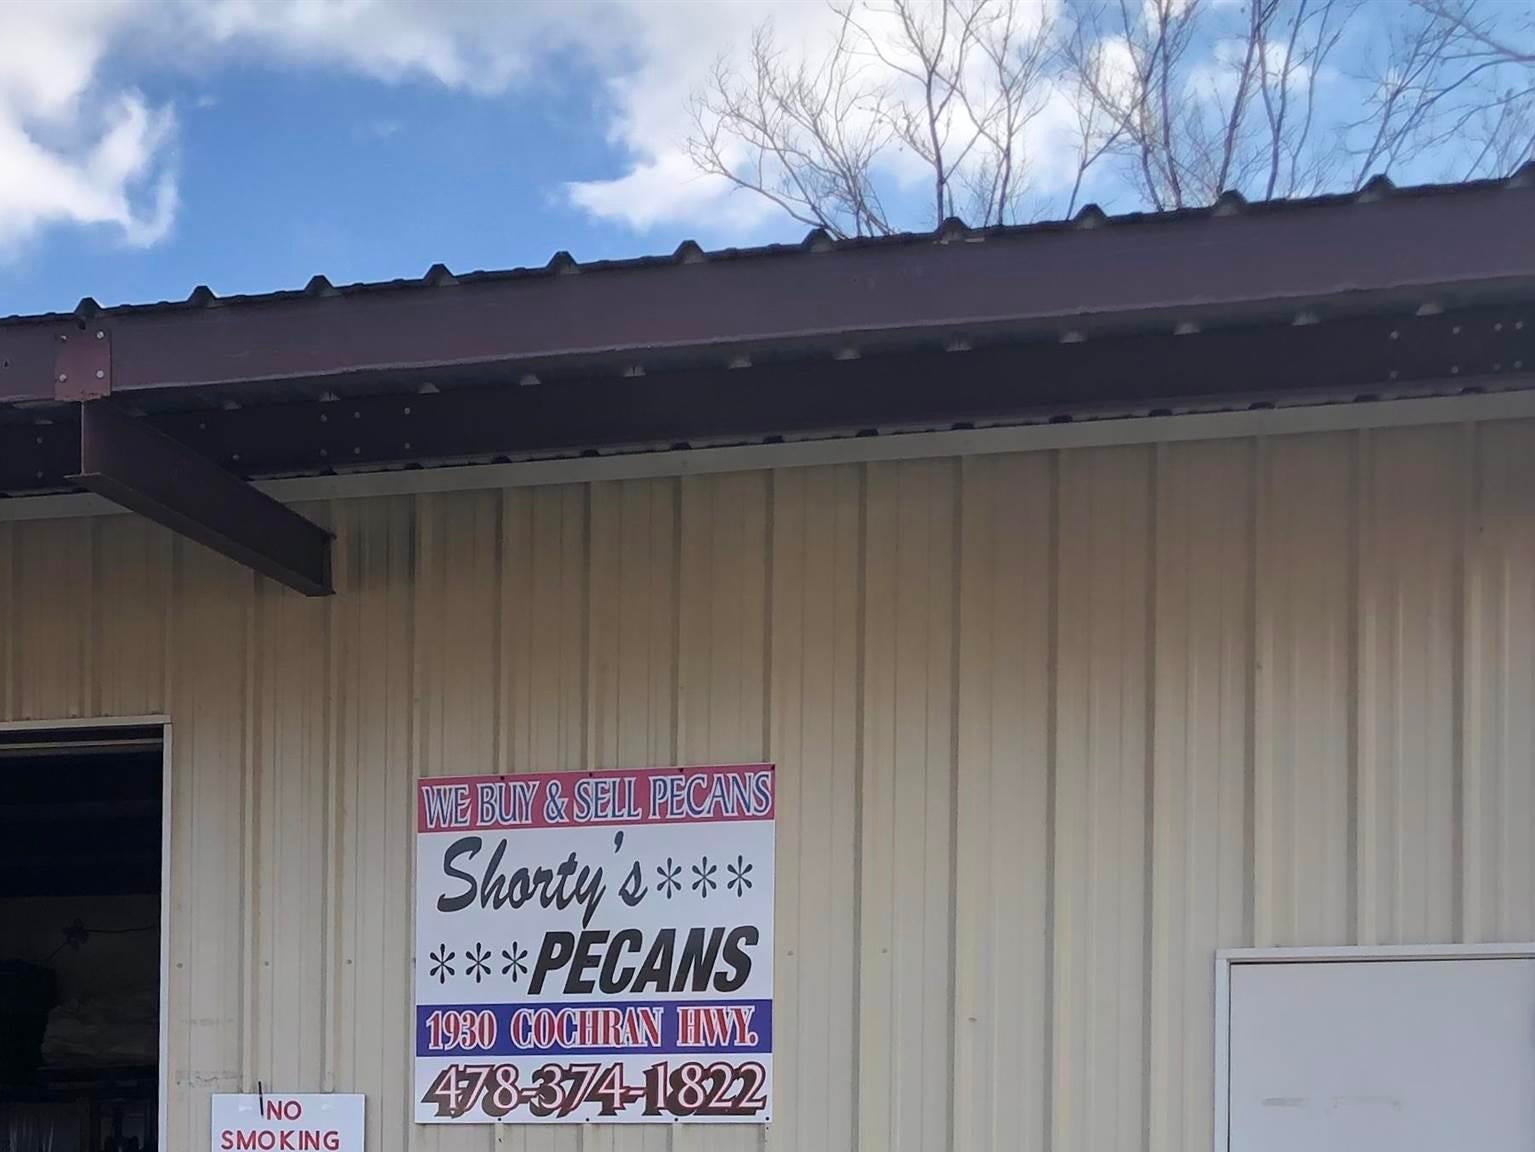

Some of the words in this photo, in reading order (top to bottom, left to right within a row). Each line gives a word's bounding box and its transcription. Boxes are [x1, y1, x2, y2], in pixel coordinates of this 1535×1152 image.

[421, 783, 473, 829] WE
[477, 779, 540, 827] BUY
[545, 778, 570, 823] &
[574, 775, 642, 822] SELL
[648, 771, 773, 819] PECANS
[436, 831, 648, 929] Shorty's
[527, 925, 760, 995] PECANS
[426, 1010, 497, 1050] 1930
[511, 1006, 664, 1049] COCHRAN
[676, 1005, 759, 1048] HWY.
[266, 1100, 302, 1121] NO
[421, 1061, 769, 1118] 478-374-1822
[221, 1130, 340, 1150] SMOKING
